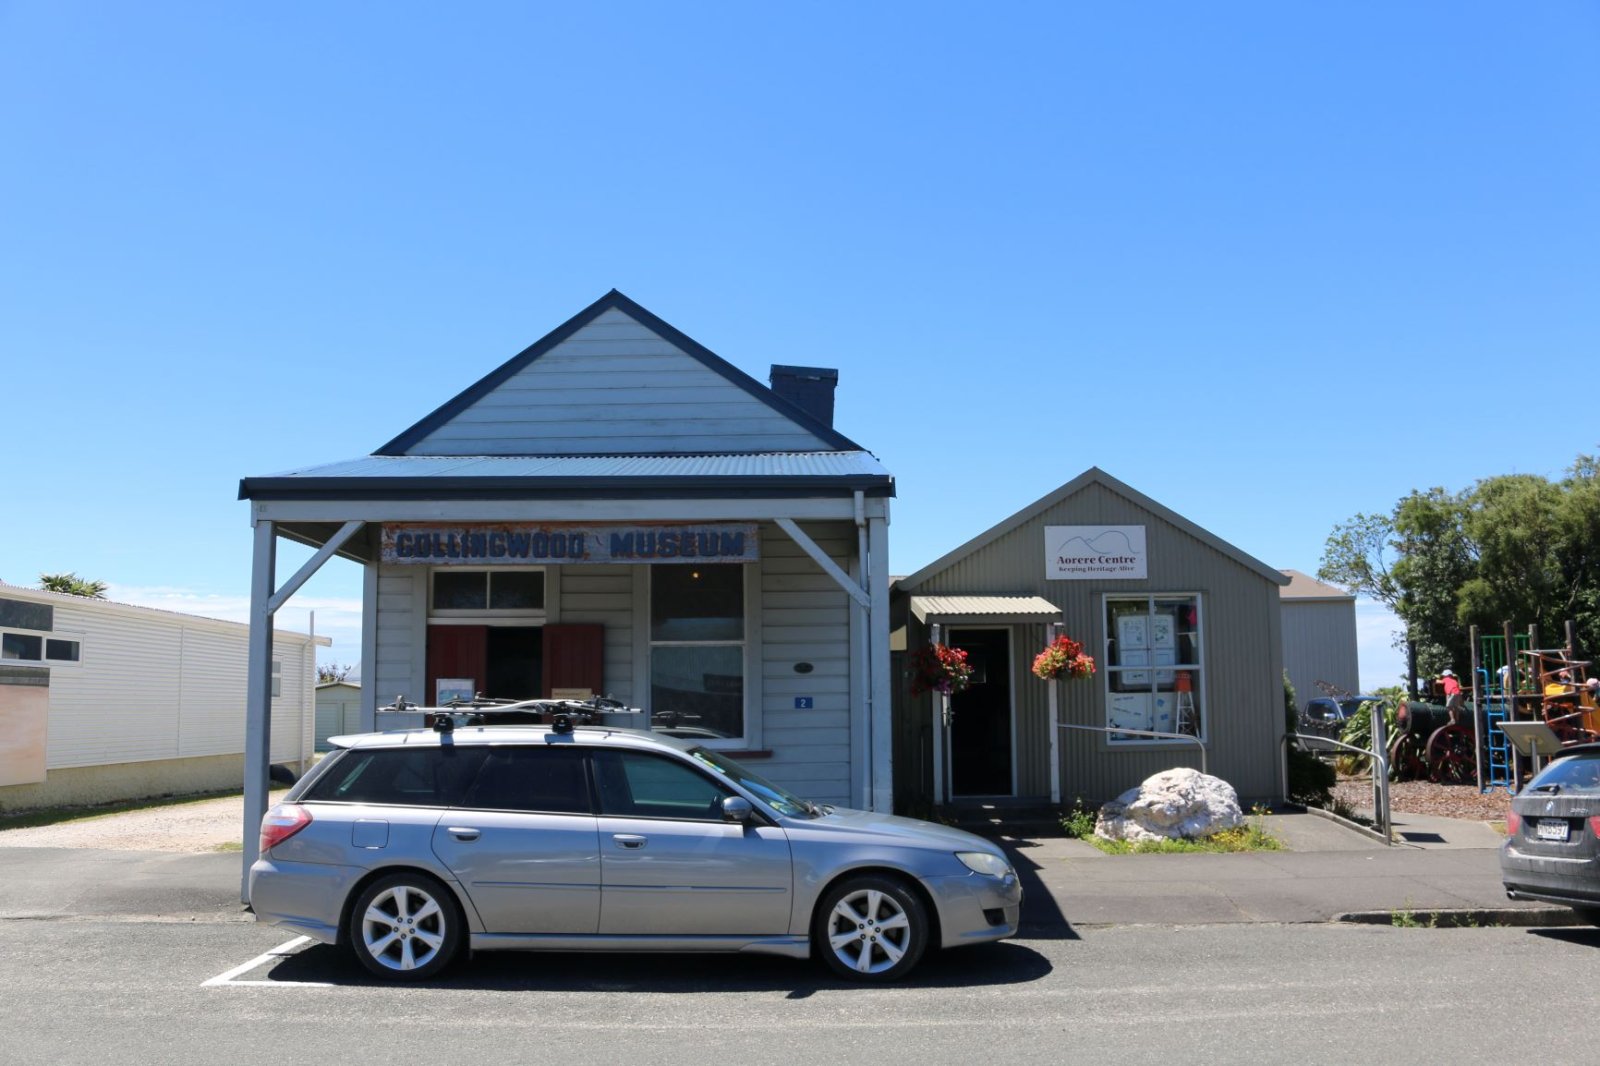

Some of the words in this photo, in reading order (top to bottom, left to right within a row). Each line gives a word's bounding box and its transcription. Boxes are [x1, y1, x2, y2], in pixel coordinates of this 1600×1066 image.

[396, 531, 584, 558] COLLINGWOOD
[610, 530, 744, 557] MUSEUM
[1057, 555, 1096, 565] Aorere
[1098, 555, 1136, 565] Centre
[800, 698, 806, 708] 2
